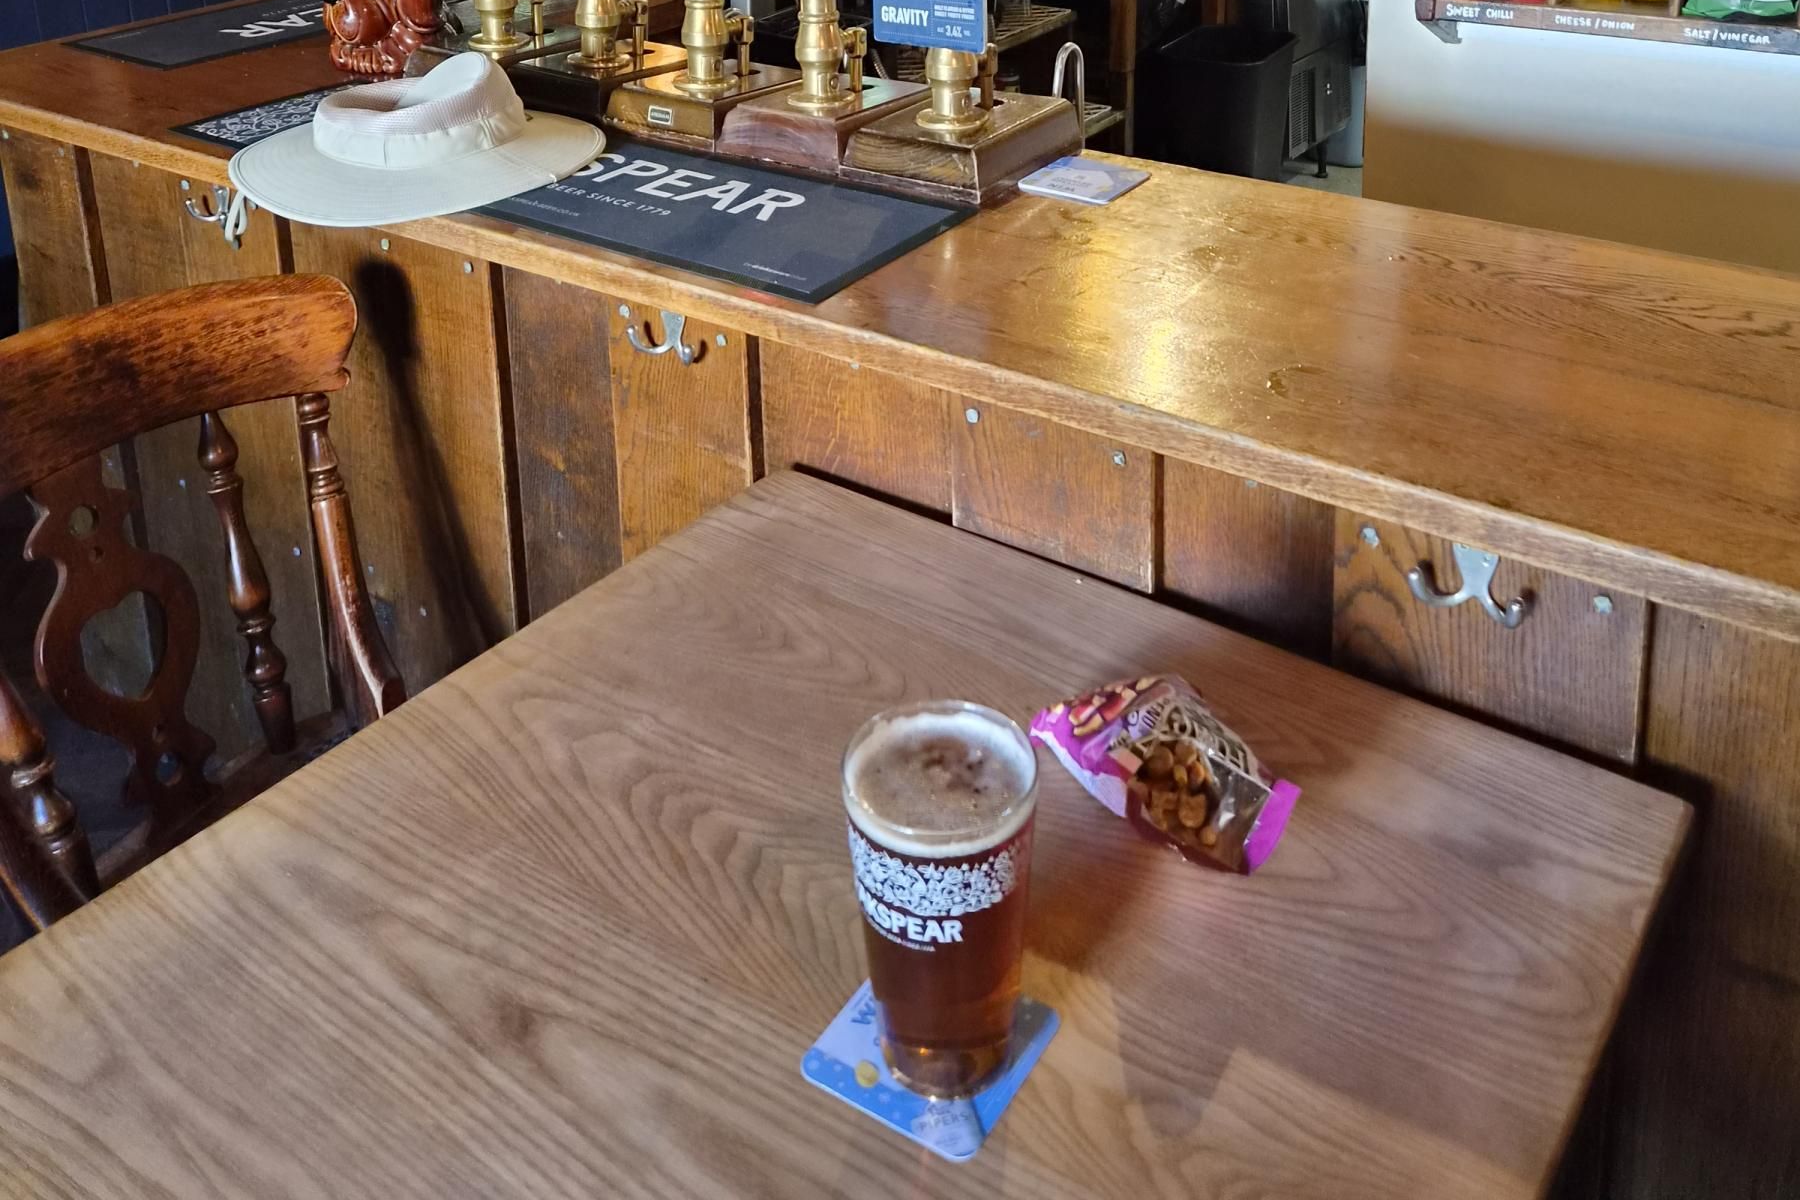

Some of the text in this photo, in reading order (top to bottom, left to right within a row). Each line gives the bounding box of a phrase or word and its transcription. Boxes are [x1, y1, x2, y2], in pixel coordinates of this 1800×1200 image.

[882, 5, 928, 27] GRAVITY
[1446, 3, 1514, 19] SWEET CHILLI
[547, 183, 586, 196] BEER
[586, 192, 635, 208] SINCE
[636, 204, 672, 217] 1779
[919, 1112, 969, 1131] PIPERS
